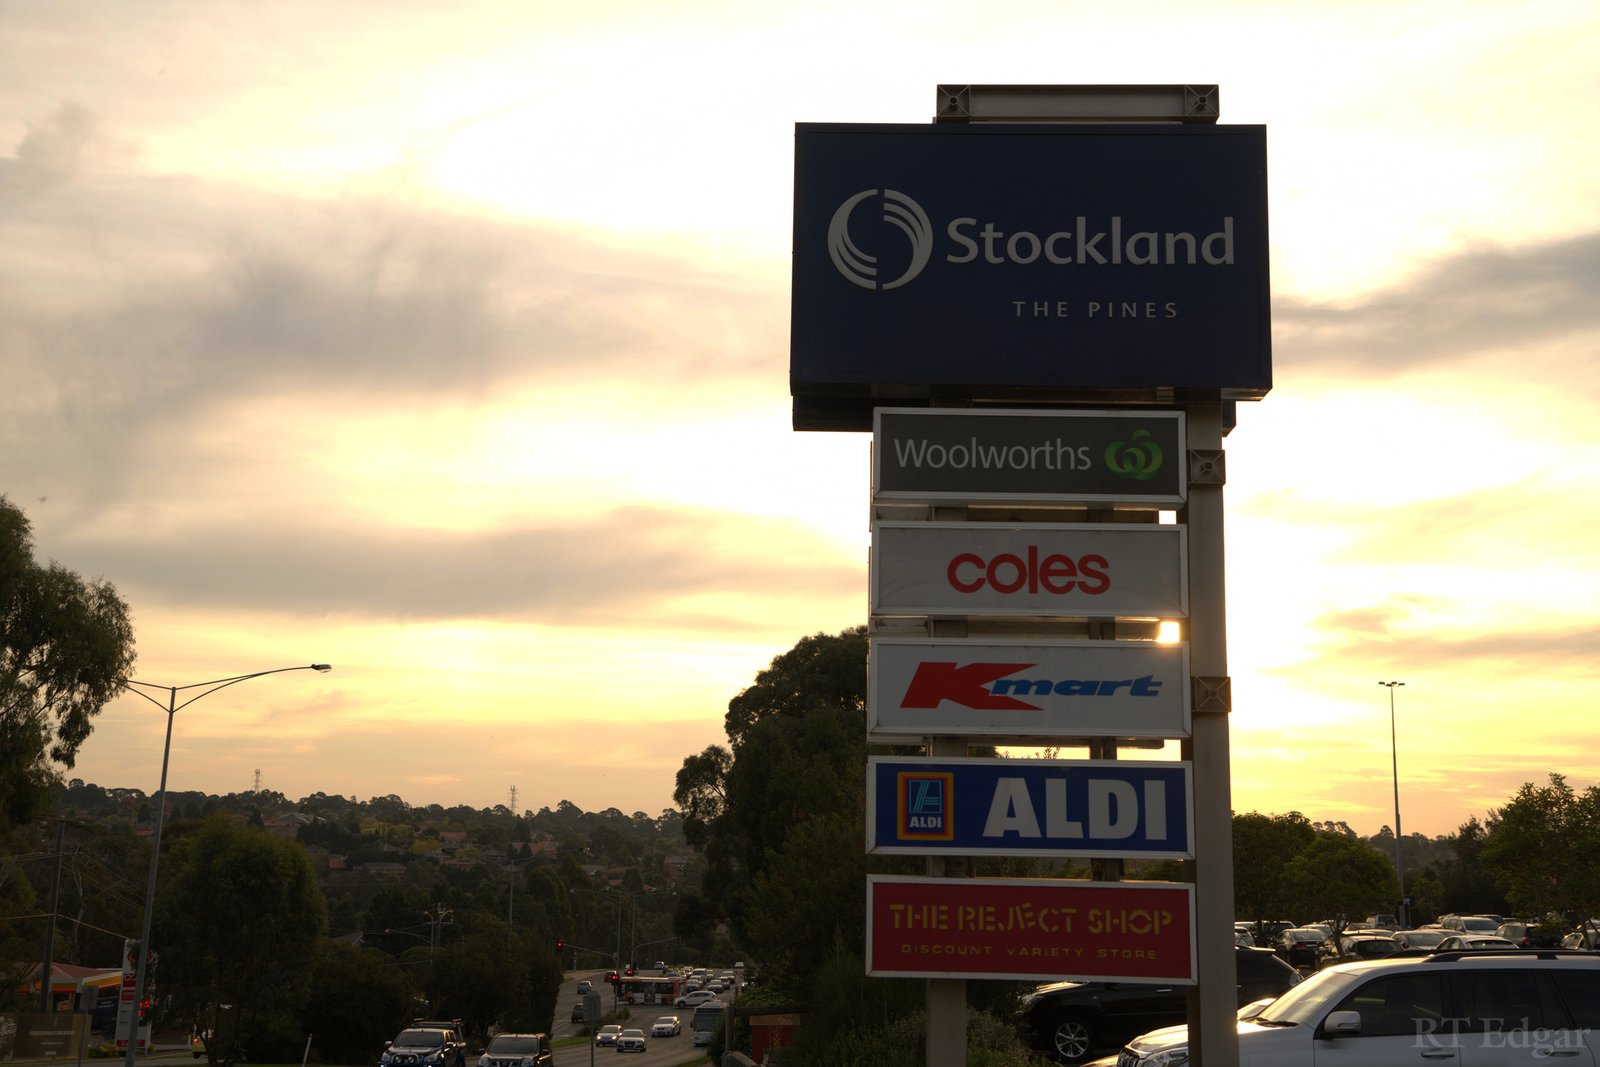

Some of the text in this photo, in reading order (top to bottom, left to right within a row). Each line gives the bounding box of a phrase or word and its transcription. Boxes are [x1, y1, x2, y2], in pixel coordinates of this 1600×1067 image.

[947, 216, 1234, 264] Stockland
[1013, 301, 1177, 318] THE PINES
[893, 437, 1092, 470] Woolworths
[947, 545, 1111, 595] coles
[900, 661, 1164, 711] Kmart
[909, 815, 942, 829] ALDI
[982, 777, 1168, 841] ALDI
[889, 901, 1172, 936] THE REJECT SHOP
[901, 944, 1158, 960] DISCOUNT VARIETY STORE
